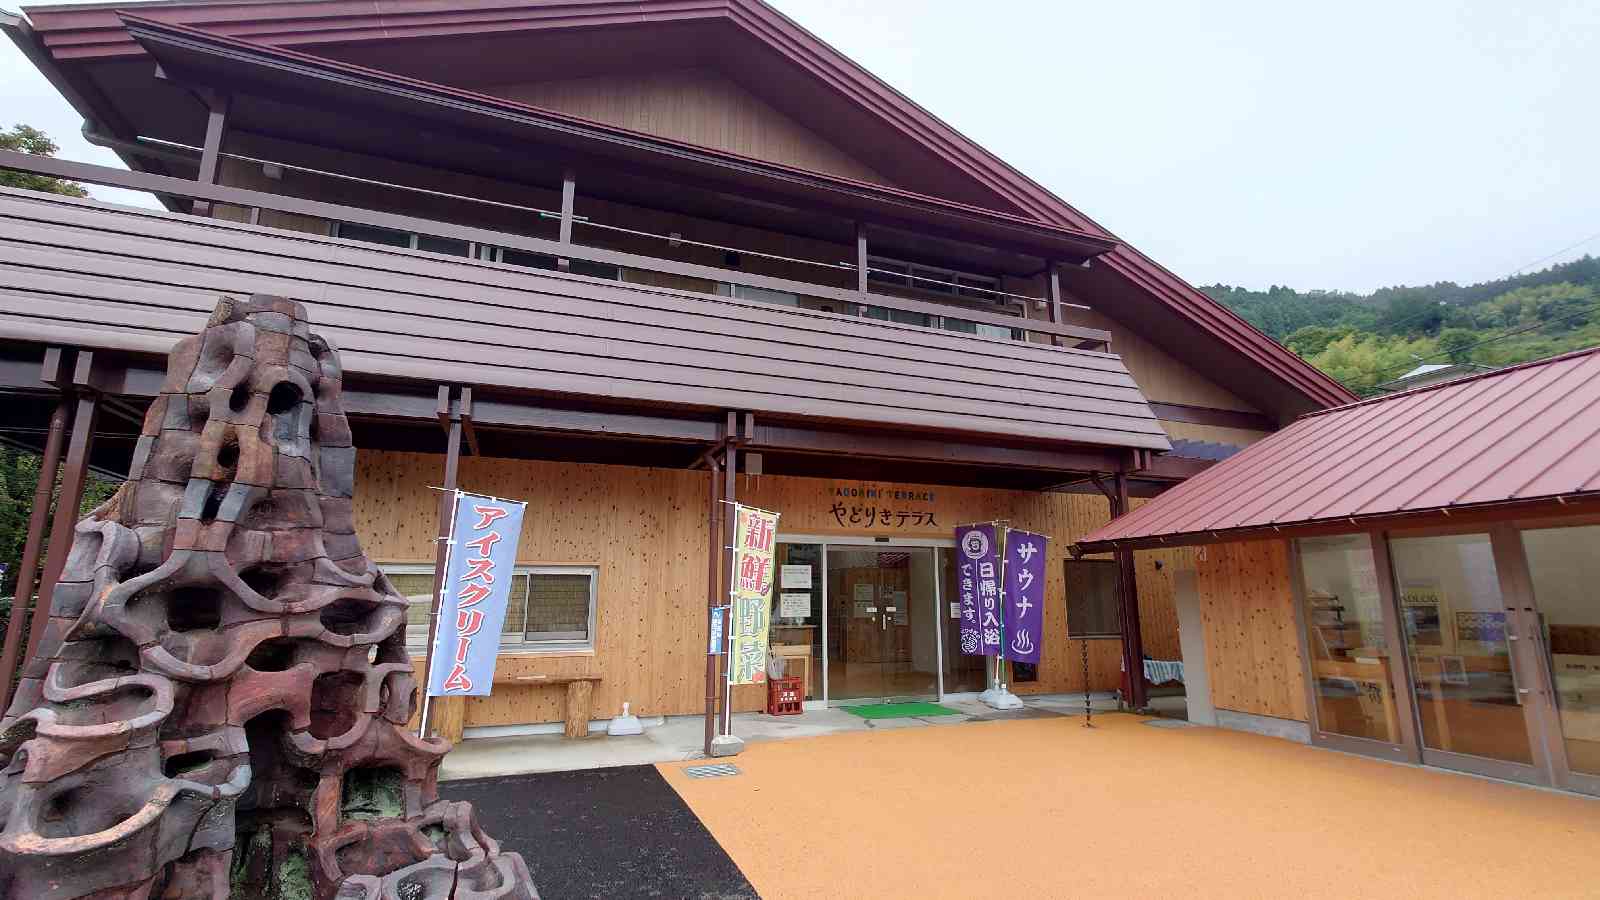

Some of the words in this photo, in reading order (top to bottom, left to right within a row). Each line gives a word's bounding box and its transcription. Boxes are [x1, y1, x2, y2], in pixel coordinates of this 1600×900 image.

[829, 501, 938, 527] やどりきテラス
[444, 505, 508, 691] アイスクリーム
[980, 562, 1000, 645] 日帰り入浴
[1016, 542, 1038, 619] サウナ
